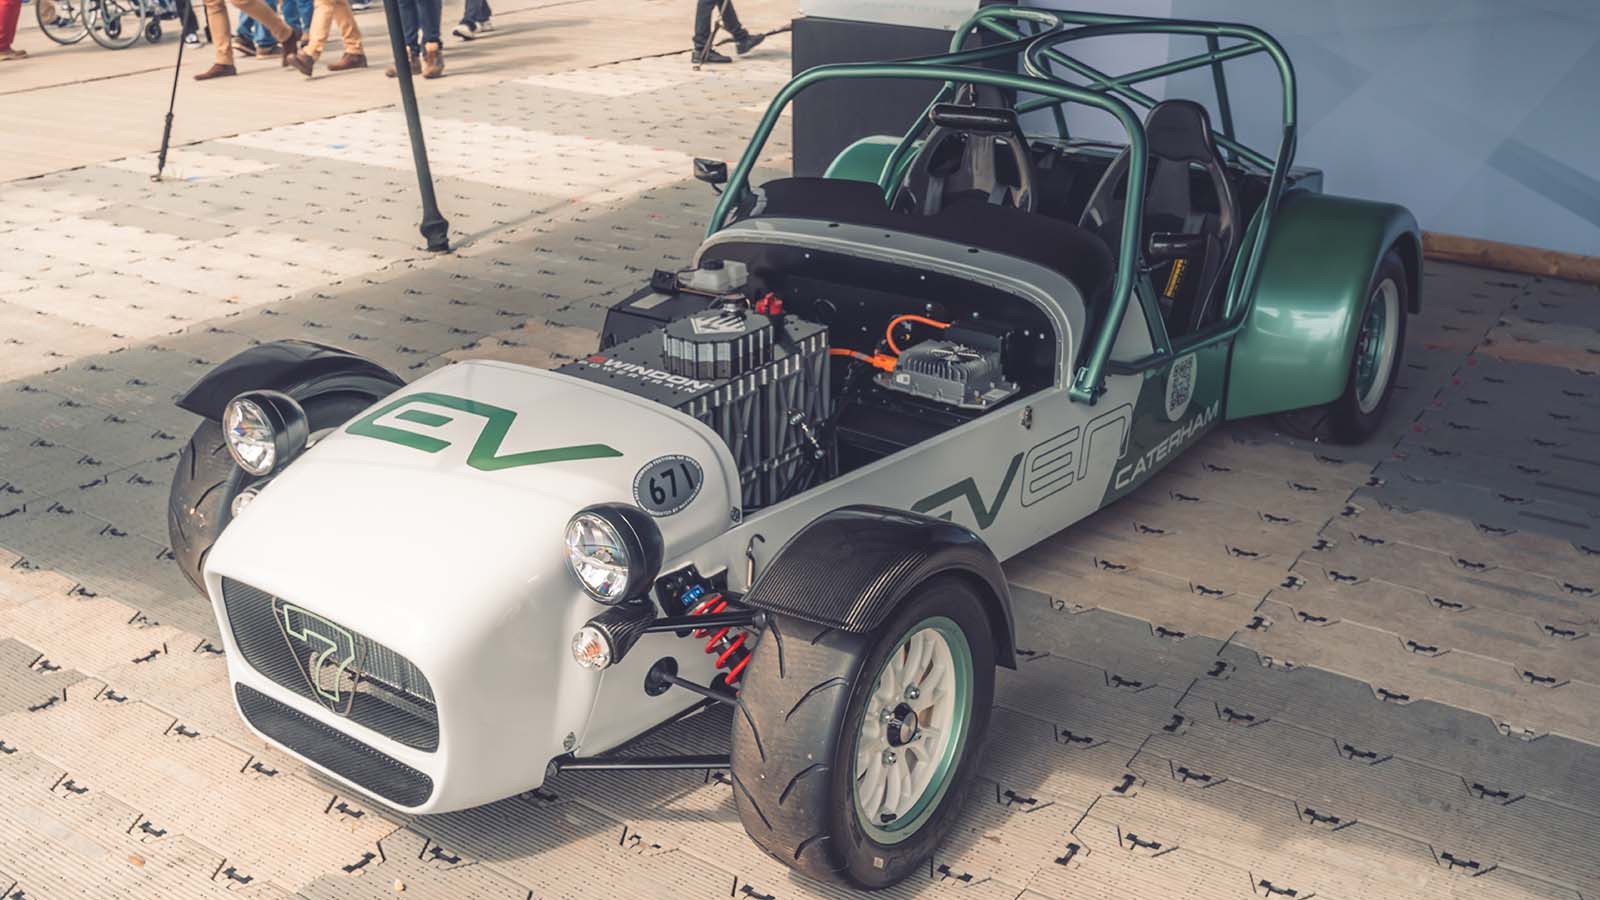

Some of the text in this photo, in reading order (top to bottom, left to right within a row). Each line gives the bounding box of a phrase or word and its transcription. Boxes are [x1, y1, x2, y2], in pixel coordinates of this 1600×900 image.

[604, 359, 709, 389] WINDON
[345, 392, 624, 471] EV
[1115, 399, 1220, 490] CATERHAM
[649, 463, 695, 505] 671
